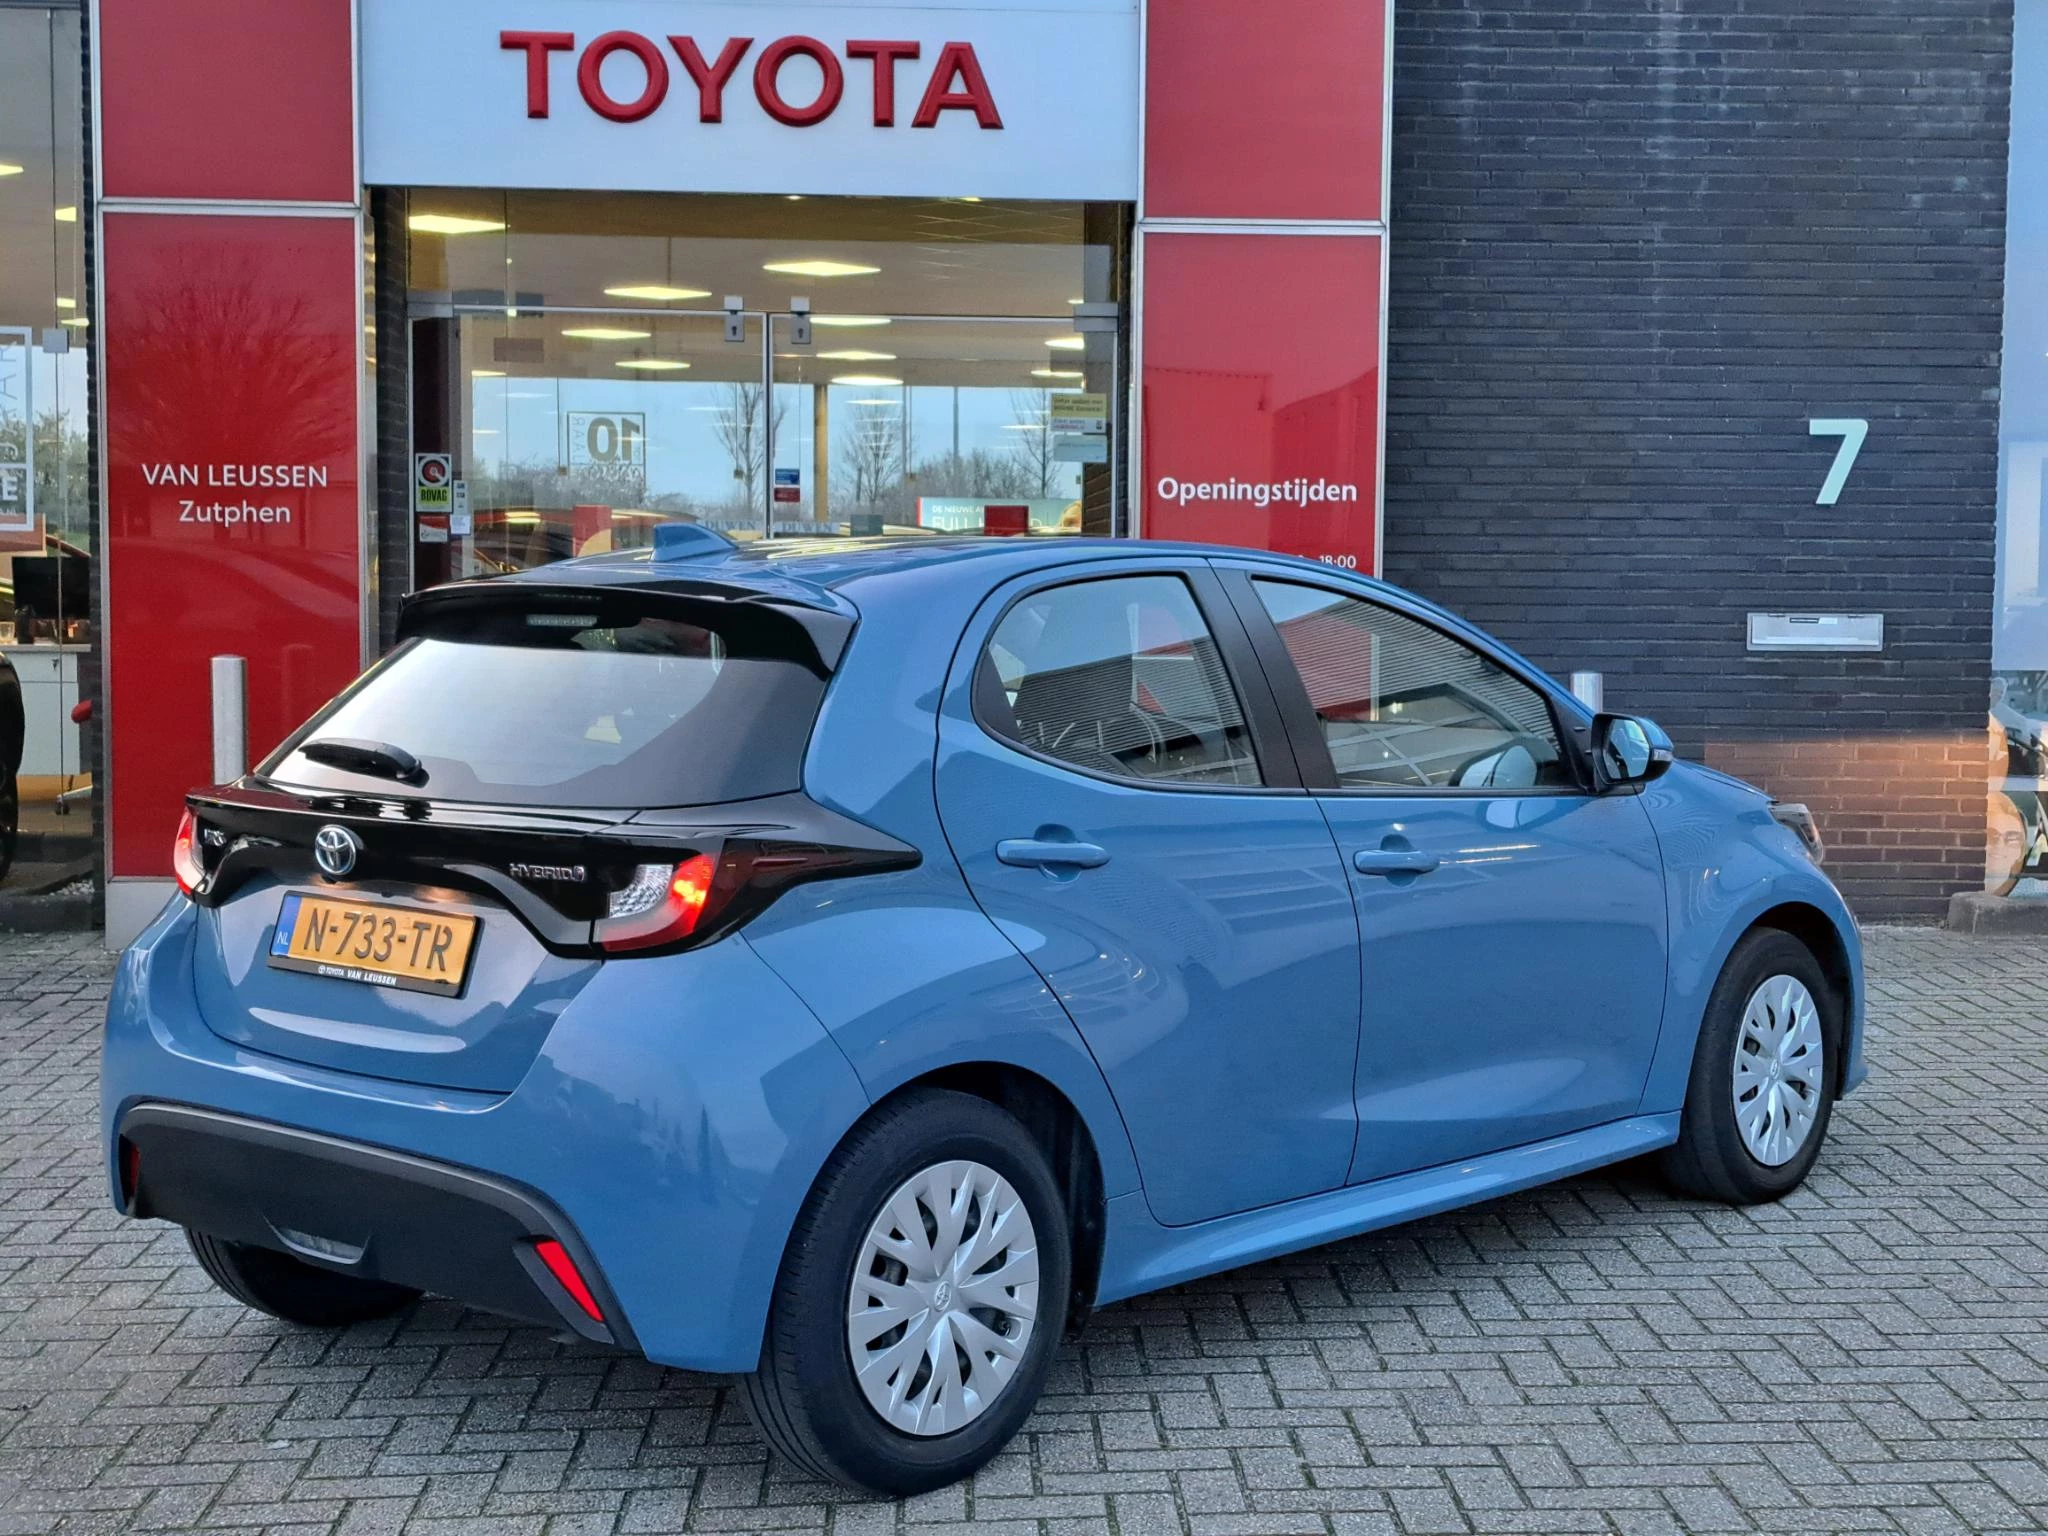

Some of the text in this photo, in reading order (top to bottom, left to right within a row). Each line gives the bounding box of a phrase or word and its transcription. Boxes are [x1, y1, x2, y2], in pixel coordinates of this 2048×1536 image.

[500, 29, 1004, 130] TOYOTA
[142, 464, 327, 487] VAN LEUSSEN
[1809, 418, 1868, 505] 7
[1157, 477, 1358, 508] Openingstijden
[179, 500, 291, 528] Zutphen
[509, 863, 573, 880] HYBRID
[277, 931, 289, 946] NL
[303, 907, 453, 972] N-733-TR
[347, 970, 361, 980] VAN
[363, 972, 397, 986] LEUSSEN
